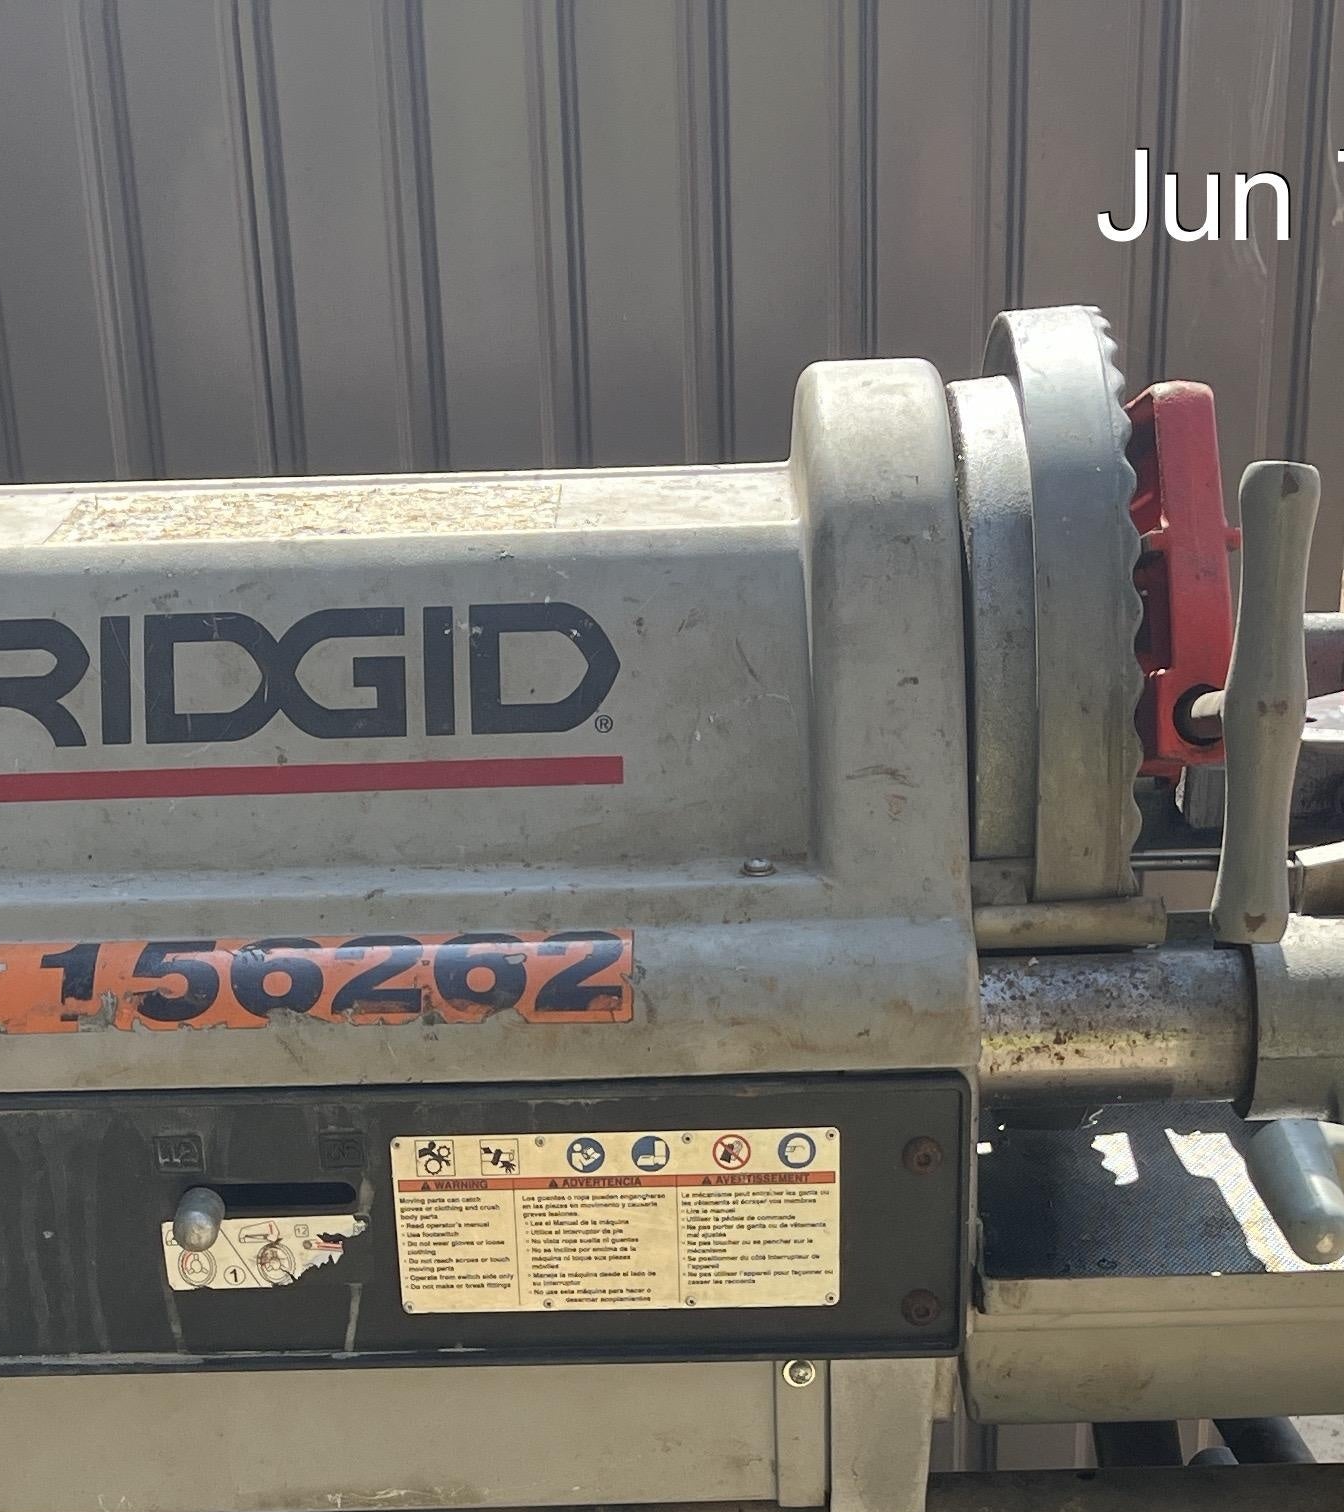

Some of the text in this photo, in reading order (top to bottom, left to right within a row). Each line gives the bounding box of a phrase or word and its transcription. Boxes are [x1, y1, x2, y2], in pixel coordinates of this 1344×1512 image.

[40, 930, 626, 1022] 156262
[562, 1177, 642, 1187] ADVERTENCIA
[716, 1173, 810, 1184] AVERTISSEMENT
[434, 1180, 488, 1189] WARNING
